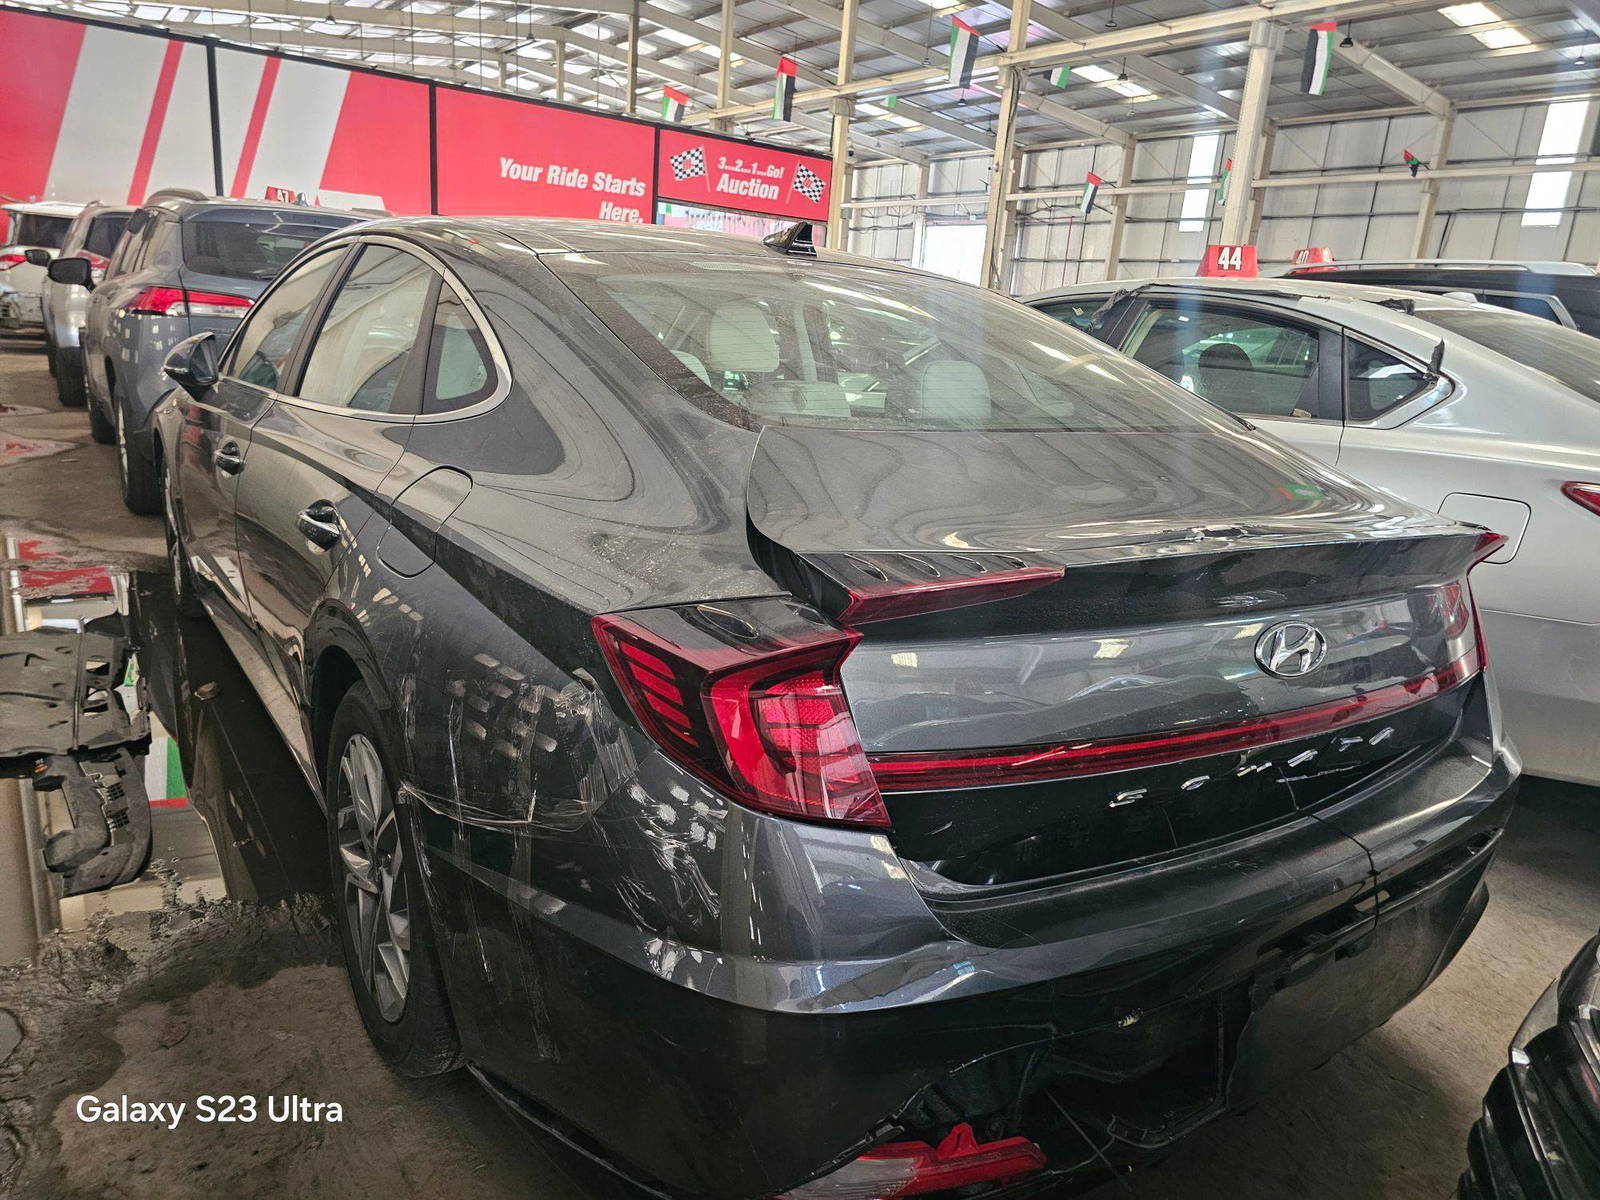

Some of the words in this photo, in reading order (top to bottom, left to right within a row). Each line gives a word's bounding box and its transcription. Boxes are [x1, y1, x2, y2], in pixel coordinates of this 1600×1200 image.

[500, 157, 543, 182] Your
[546, 165, 588, 189] Ride
[592, 171, 646, 197] Starts
[716, 173, 780, 200] Auction
[599, 201, 644, 224] Here.
[1218, 246, 1242, 270] 44
